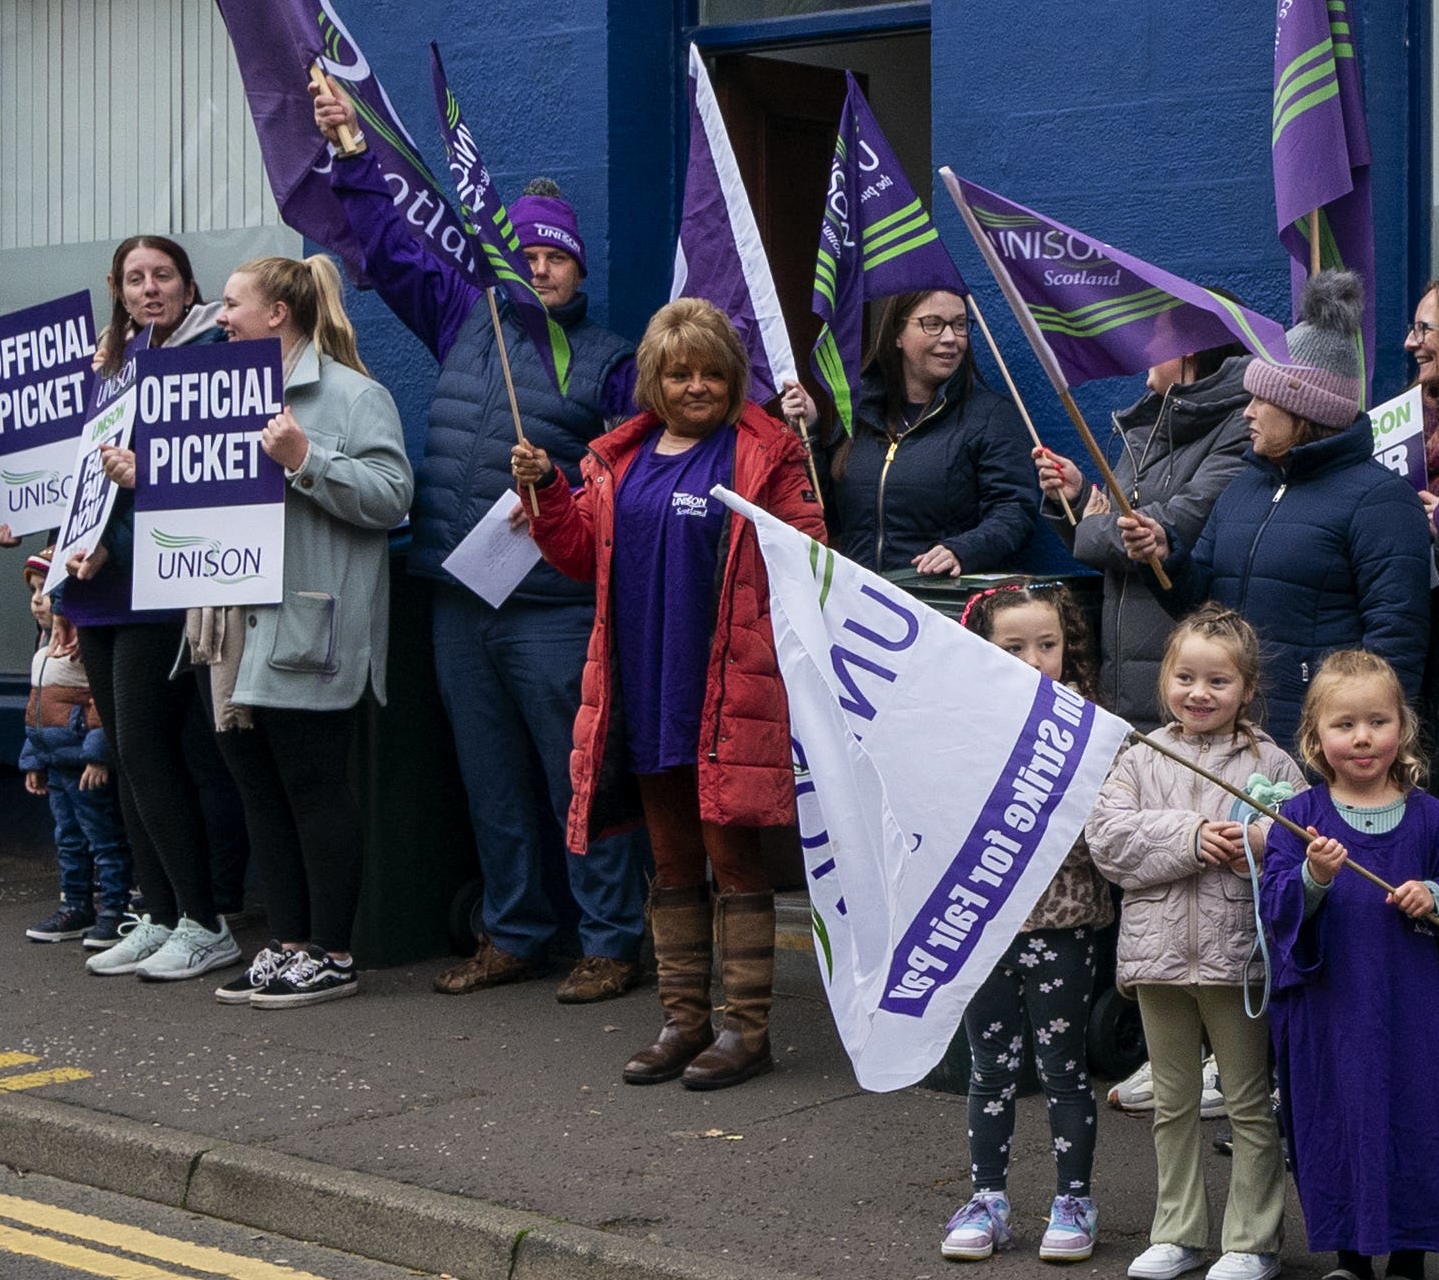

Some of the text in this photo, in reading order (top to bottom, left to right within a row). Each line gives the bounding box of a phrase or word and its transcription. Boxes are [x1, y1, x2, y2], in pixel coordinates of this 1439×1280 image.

[1043, 269, 1121, 287] Scotland
[140, 366, 282, 424] OFFICIAL
[149, 430, 263, 486] PICKET
[8, 471, 70, 512] UNISO
[157, 547, 262, 580] UNISON
